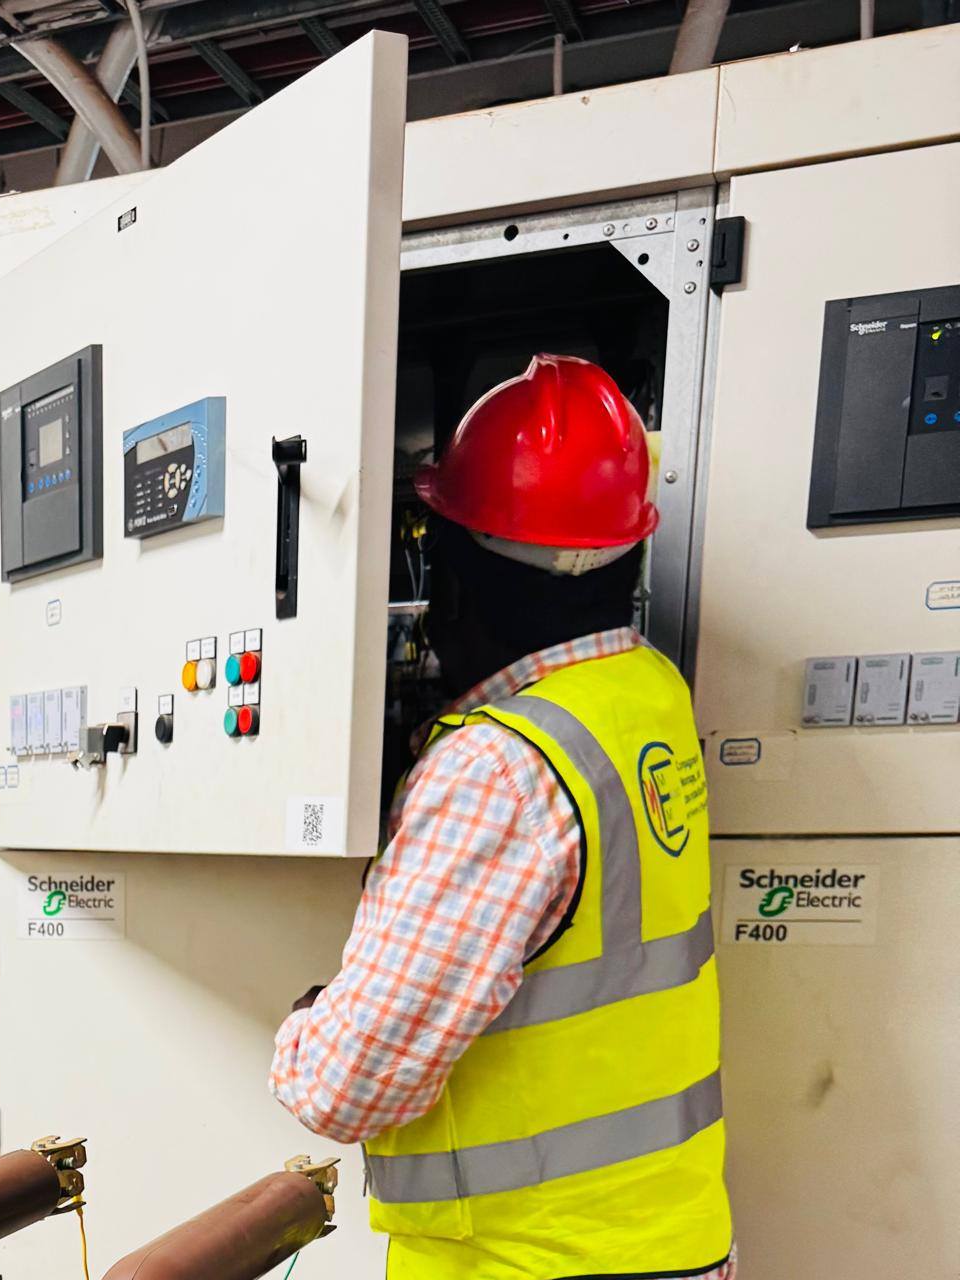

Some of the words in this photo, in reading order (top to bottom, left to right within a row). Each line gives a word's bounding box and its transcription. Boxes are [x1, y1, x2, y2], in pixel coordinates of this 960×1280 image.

[27, 875, 115, 892] Schneider
[740, 868, 866, 889] Schneider
[67, 894, 115, 909] Electric
[796, 891, 862, 908] Electric
[27, 922, 64, 937] F400
[734, 923, 788, 942] F400
